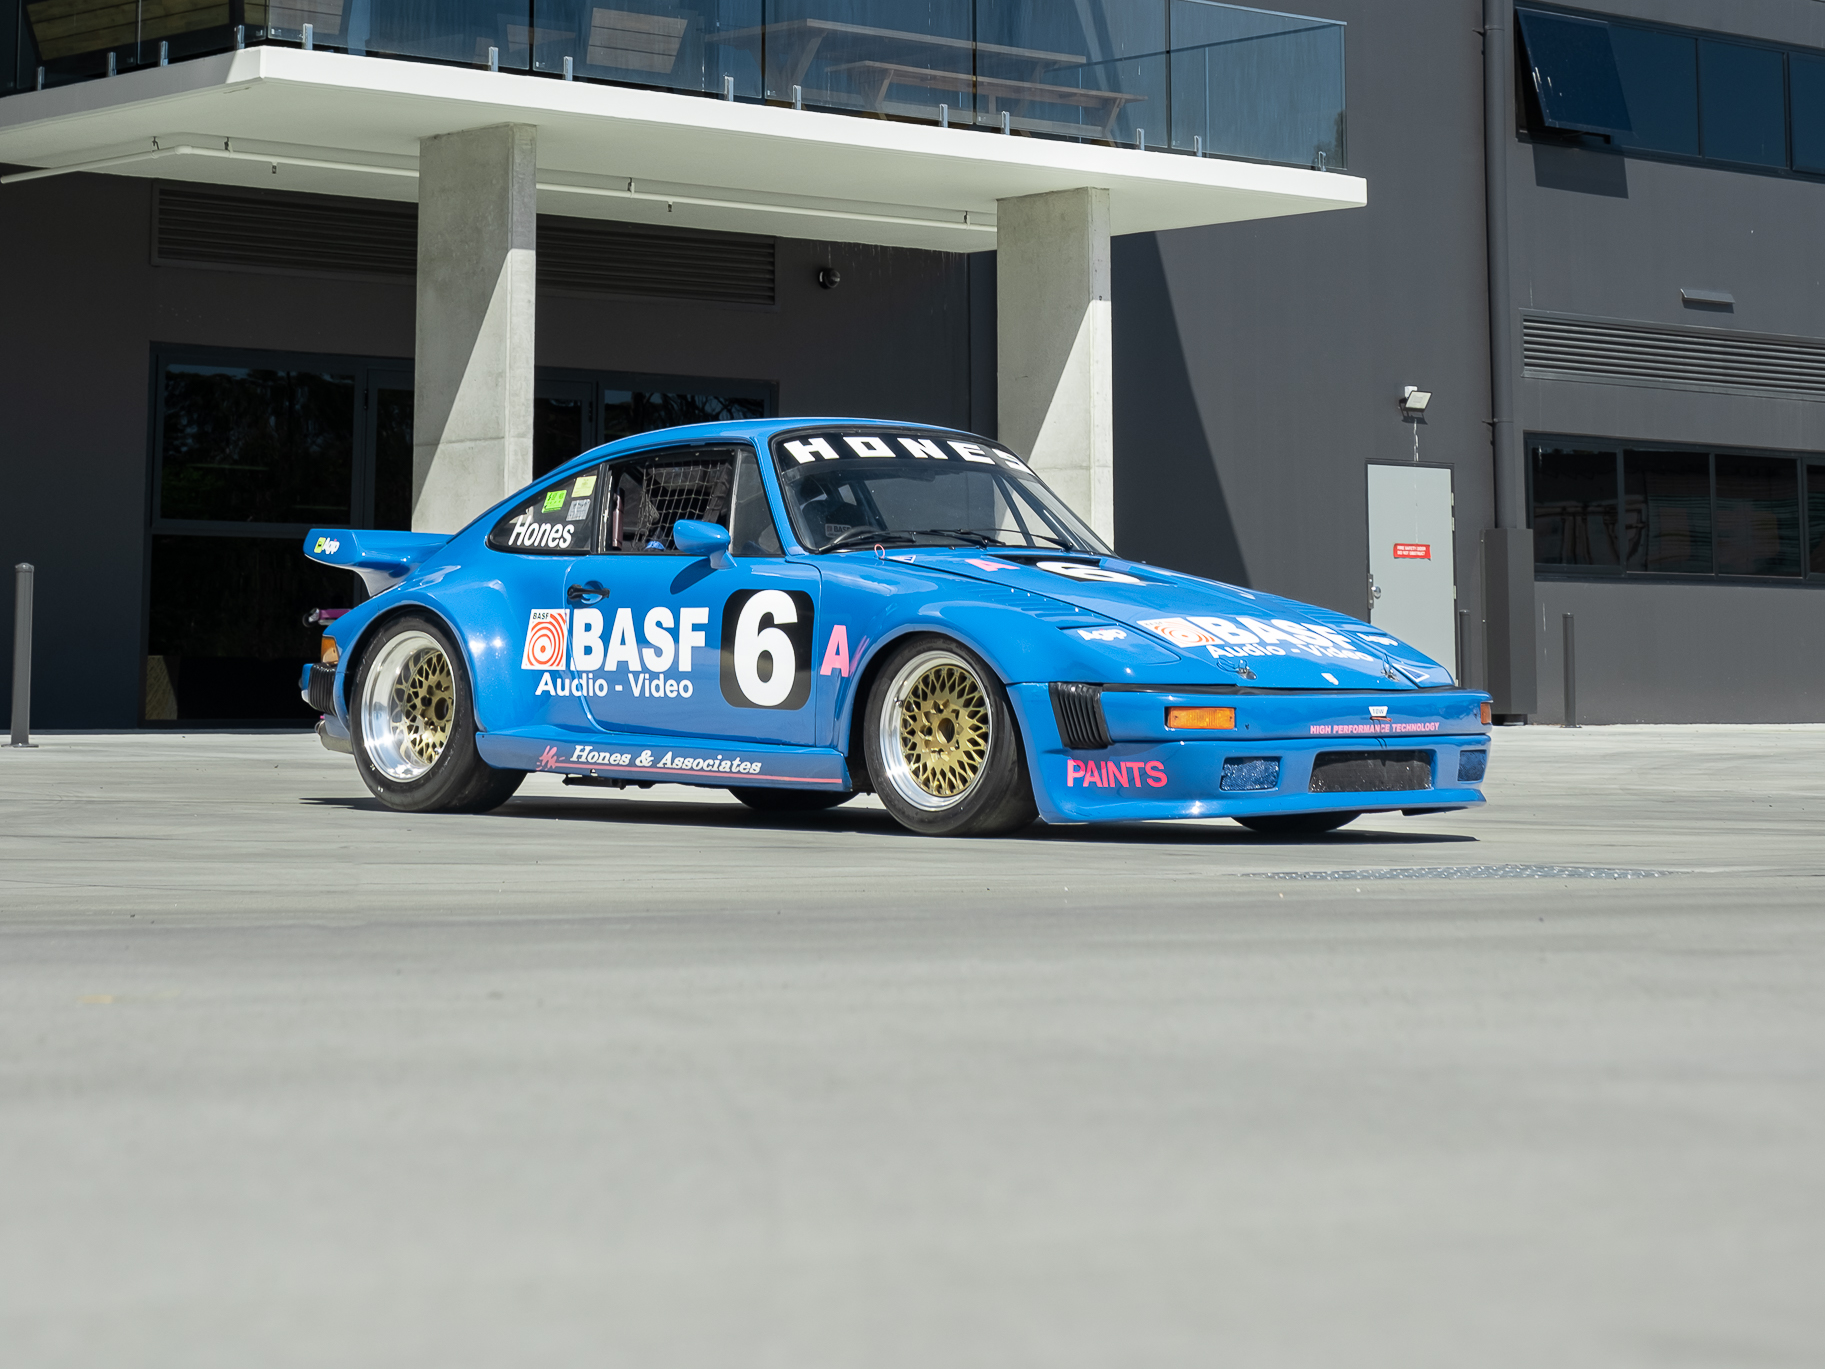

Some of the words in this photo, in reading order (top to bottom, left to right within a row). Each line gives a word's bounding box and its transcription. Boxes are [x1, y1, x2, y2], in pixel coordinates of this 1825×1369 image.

[783, 437, 1035, 476] HONES
[508, 515, 574, 548] Hones
[533, 612, 549, 620] BASF
[570, 607, 709, 672] BASF
[733, 589, 798, 707] 6
[1077, 628, 1128, 641] Agip
[1186, 616, 1357, 651] BASF
[820, 624, 849, 678] A
[1206, 644, 1286, 659] Audio
[1303, 643, 1374, 662] Video
[535, 672, 608, 697] Audio
[628, 673, 694, 698] Video
[1310, 725, 1331, 734] HIGH
[1333, 724, 1390, 734] PERFORMANCE
[1392, 722, 1440, 732] TECHNOLOGY
[570, 744, 631, 766] Hones
[635, 749, 655, 767] &
[657, 751, 762, 774] Associates
[1067, 759, 1168, 788] PAINTS
